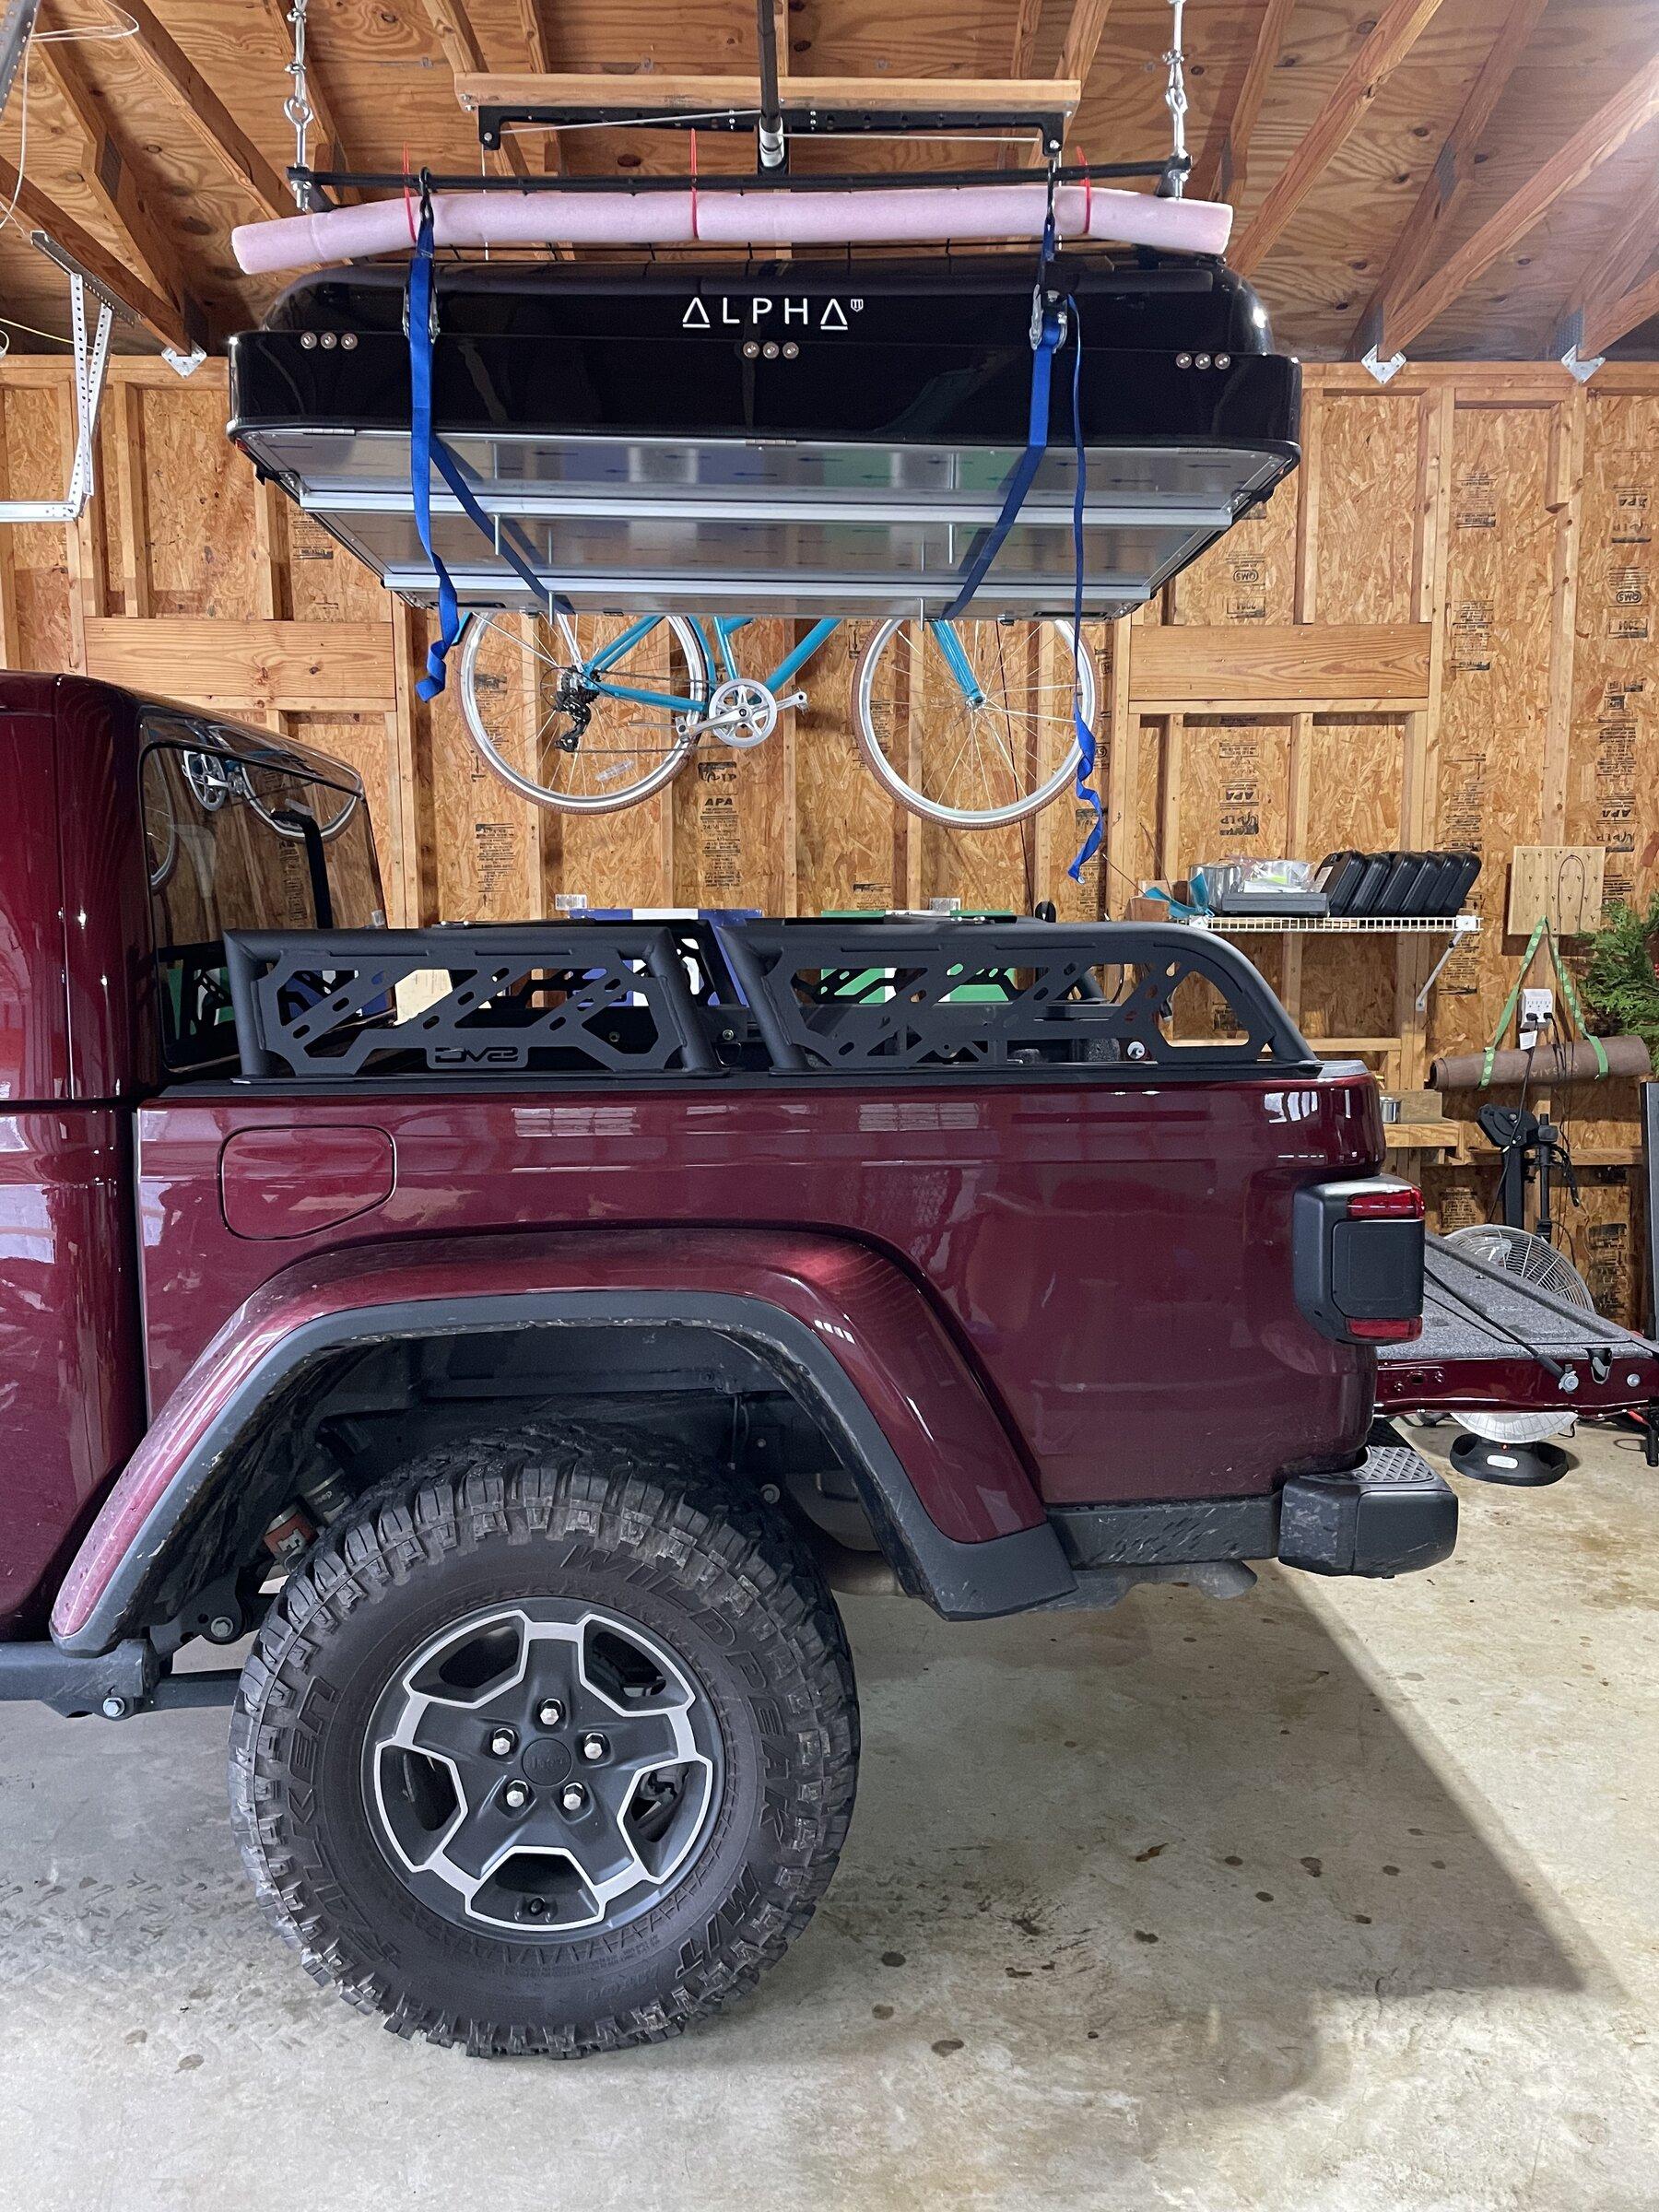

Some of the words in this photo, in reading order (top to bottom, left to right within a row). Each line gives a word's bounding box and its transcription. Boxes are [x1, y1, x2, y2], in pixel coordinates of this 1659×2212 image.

[682, 297, 849, 330] ALPHA
[1236, 571, 1256, 581] QMS
[1617, 592, 1641, 602] QMS
[1225, 791, 1254, 801] APA
[704, 797, 734, 806] APA
[1602, 809, 1631, 818] APA
[560, 1544, 790, 1846] WILDPEAK
[288, 1674, 400, 1969] FALKEN
